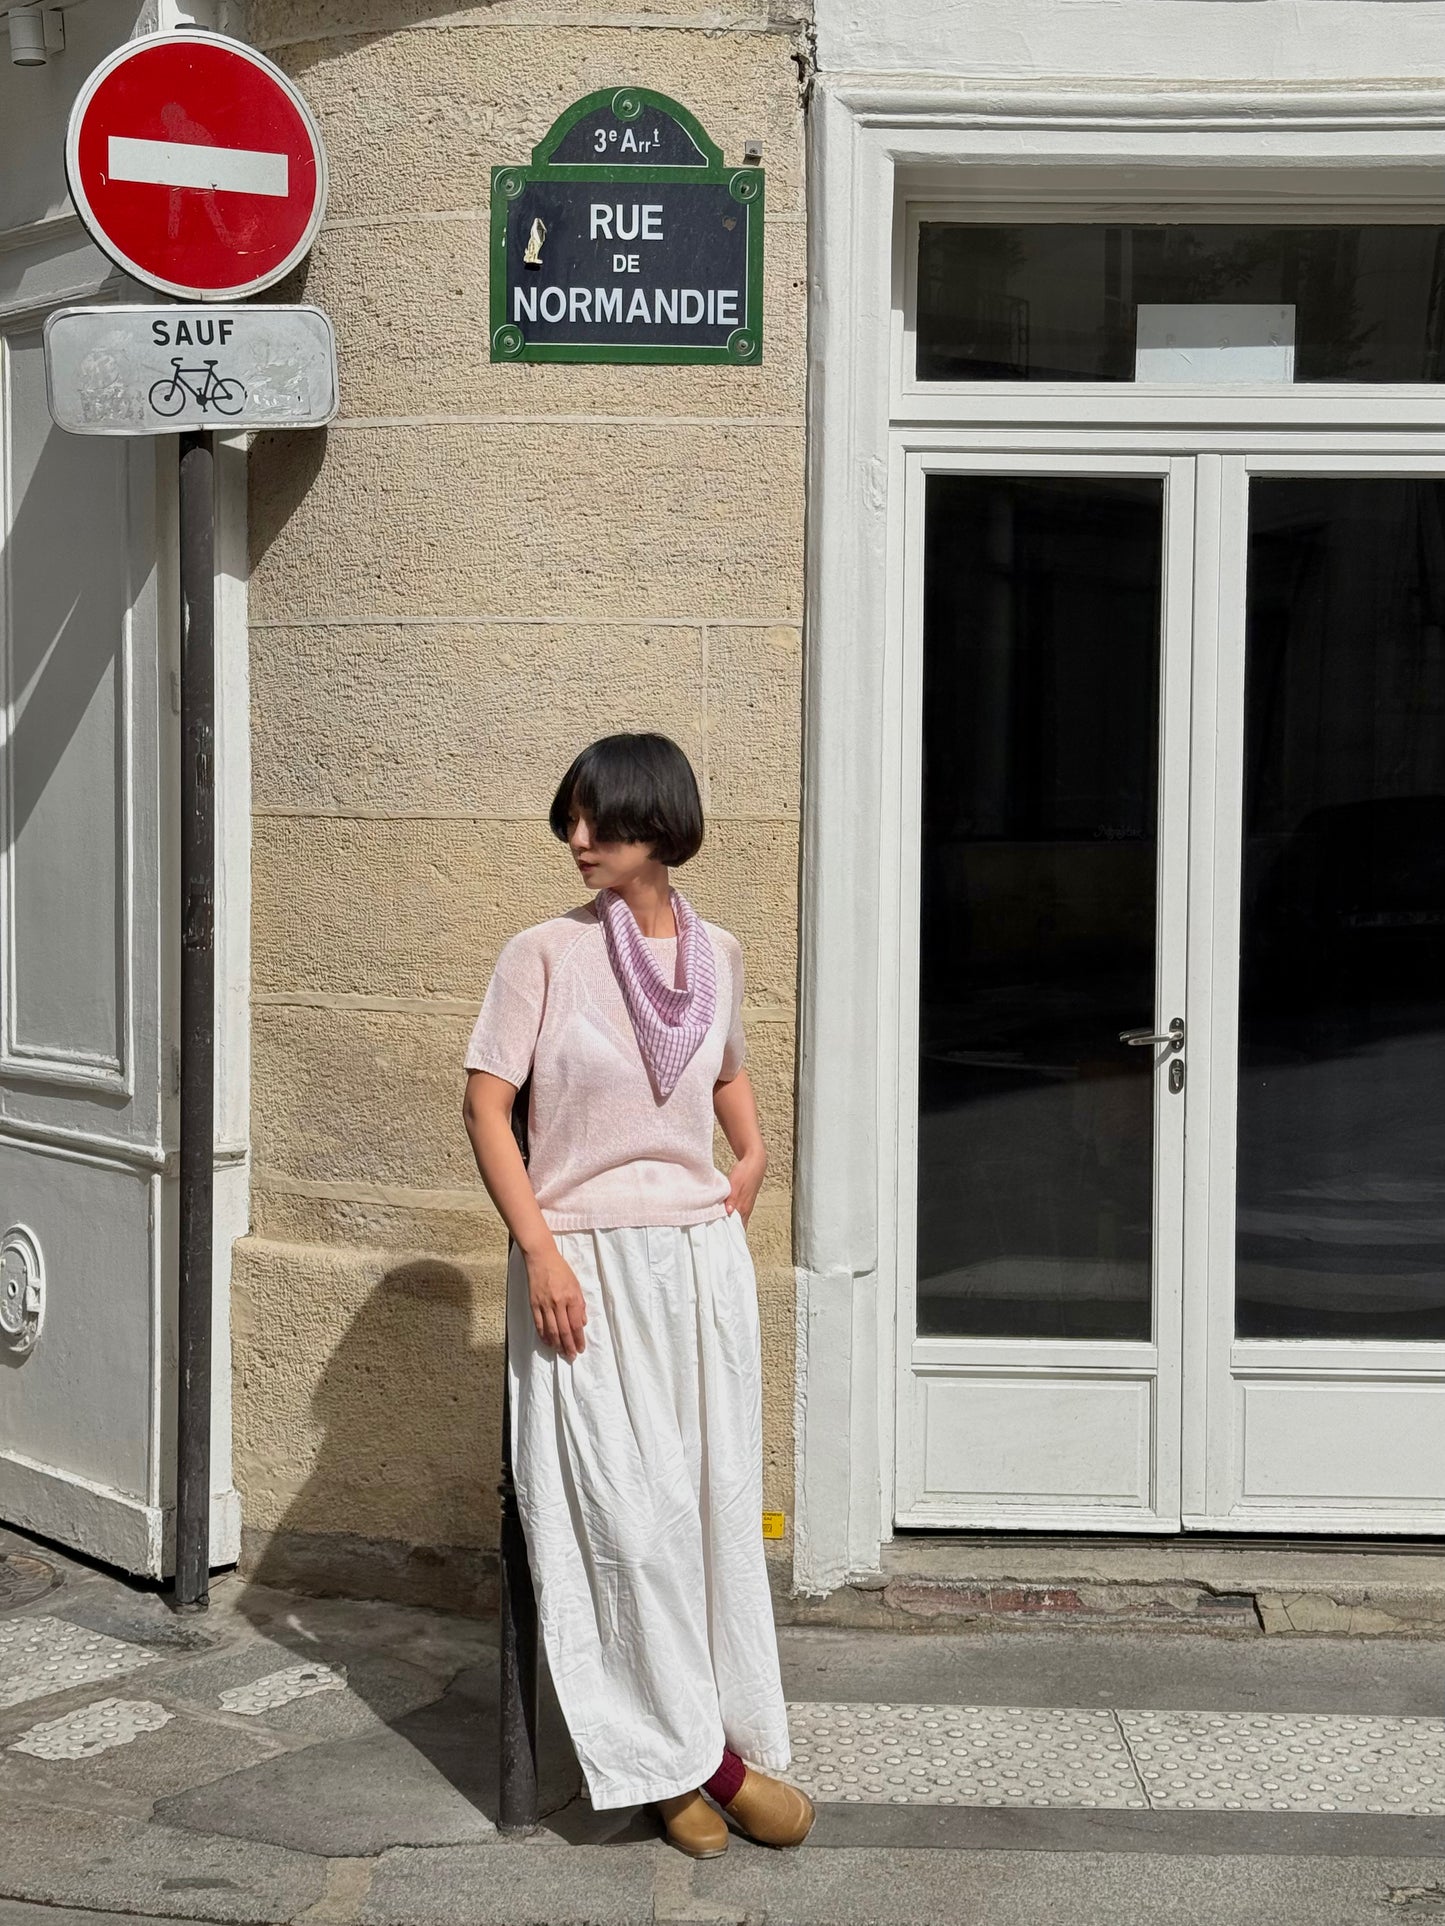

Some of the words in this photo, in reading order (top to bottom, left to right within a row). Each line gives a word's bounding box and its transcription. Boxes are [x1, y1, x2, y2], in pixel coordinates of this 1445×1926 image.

[590, 203, 664, 241] RUE
[612, 254, 640, 273] DE
[513, 286, 739, 325] NORMANDIE
[152, 319, 233, 346] SAUF
